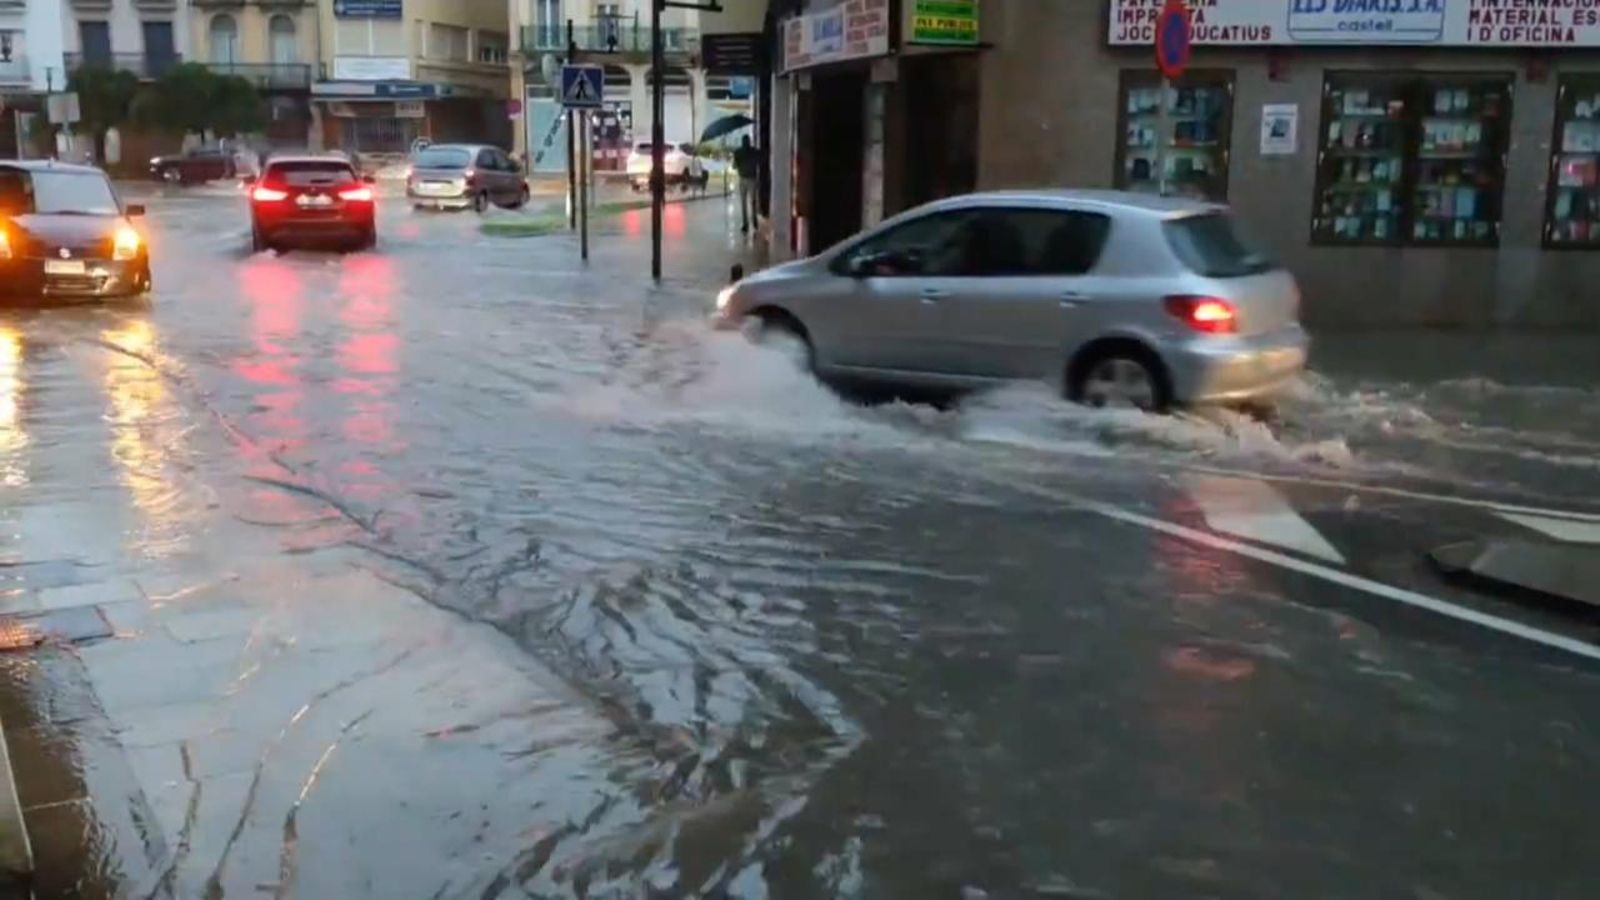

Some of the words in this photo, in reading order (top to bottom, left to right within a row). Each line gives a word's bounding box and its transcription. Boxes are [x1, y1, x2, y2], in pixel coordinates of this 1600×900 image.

[1117, 8, 1205, 23] IMPRTA
[1468, 9, 1561, 25] MATERIAL
[1337, 19, 1393, 32] castell
[1117, 26, 1152, 41] JOC
[1467, 27, 1472, 41] I
